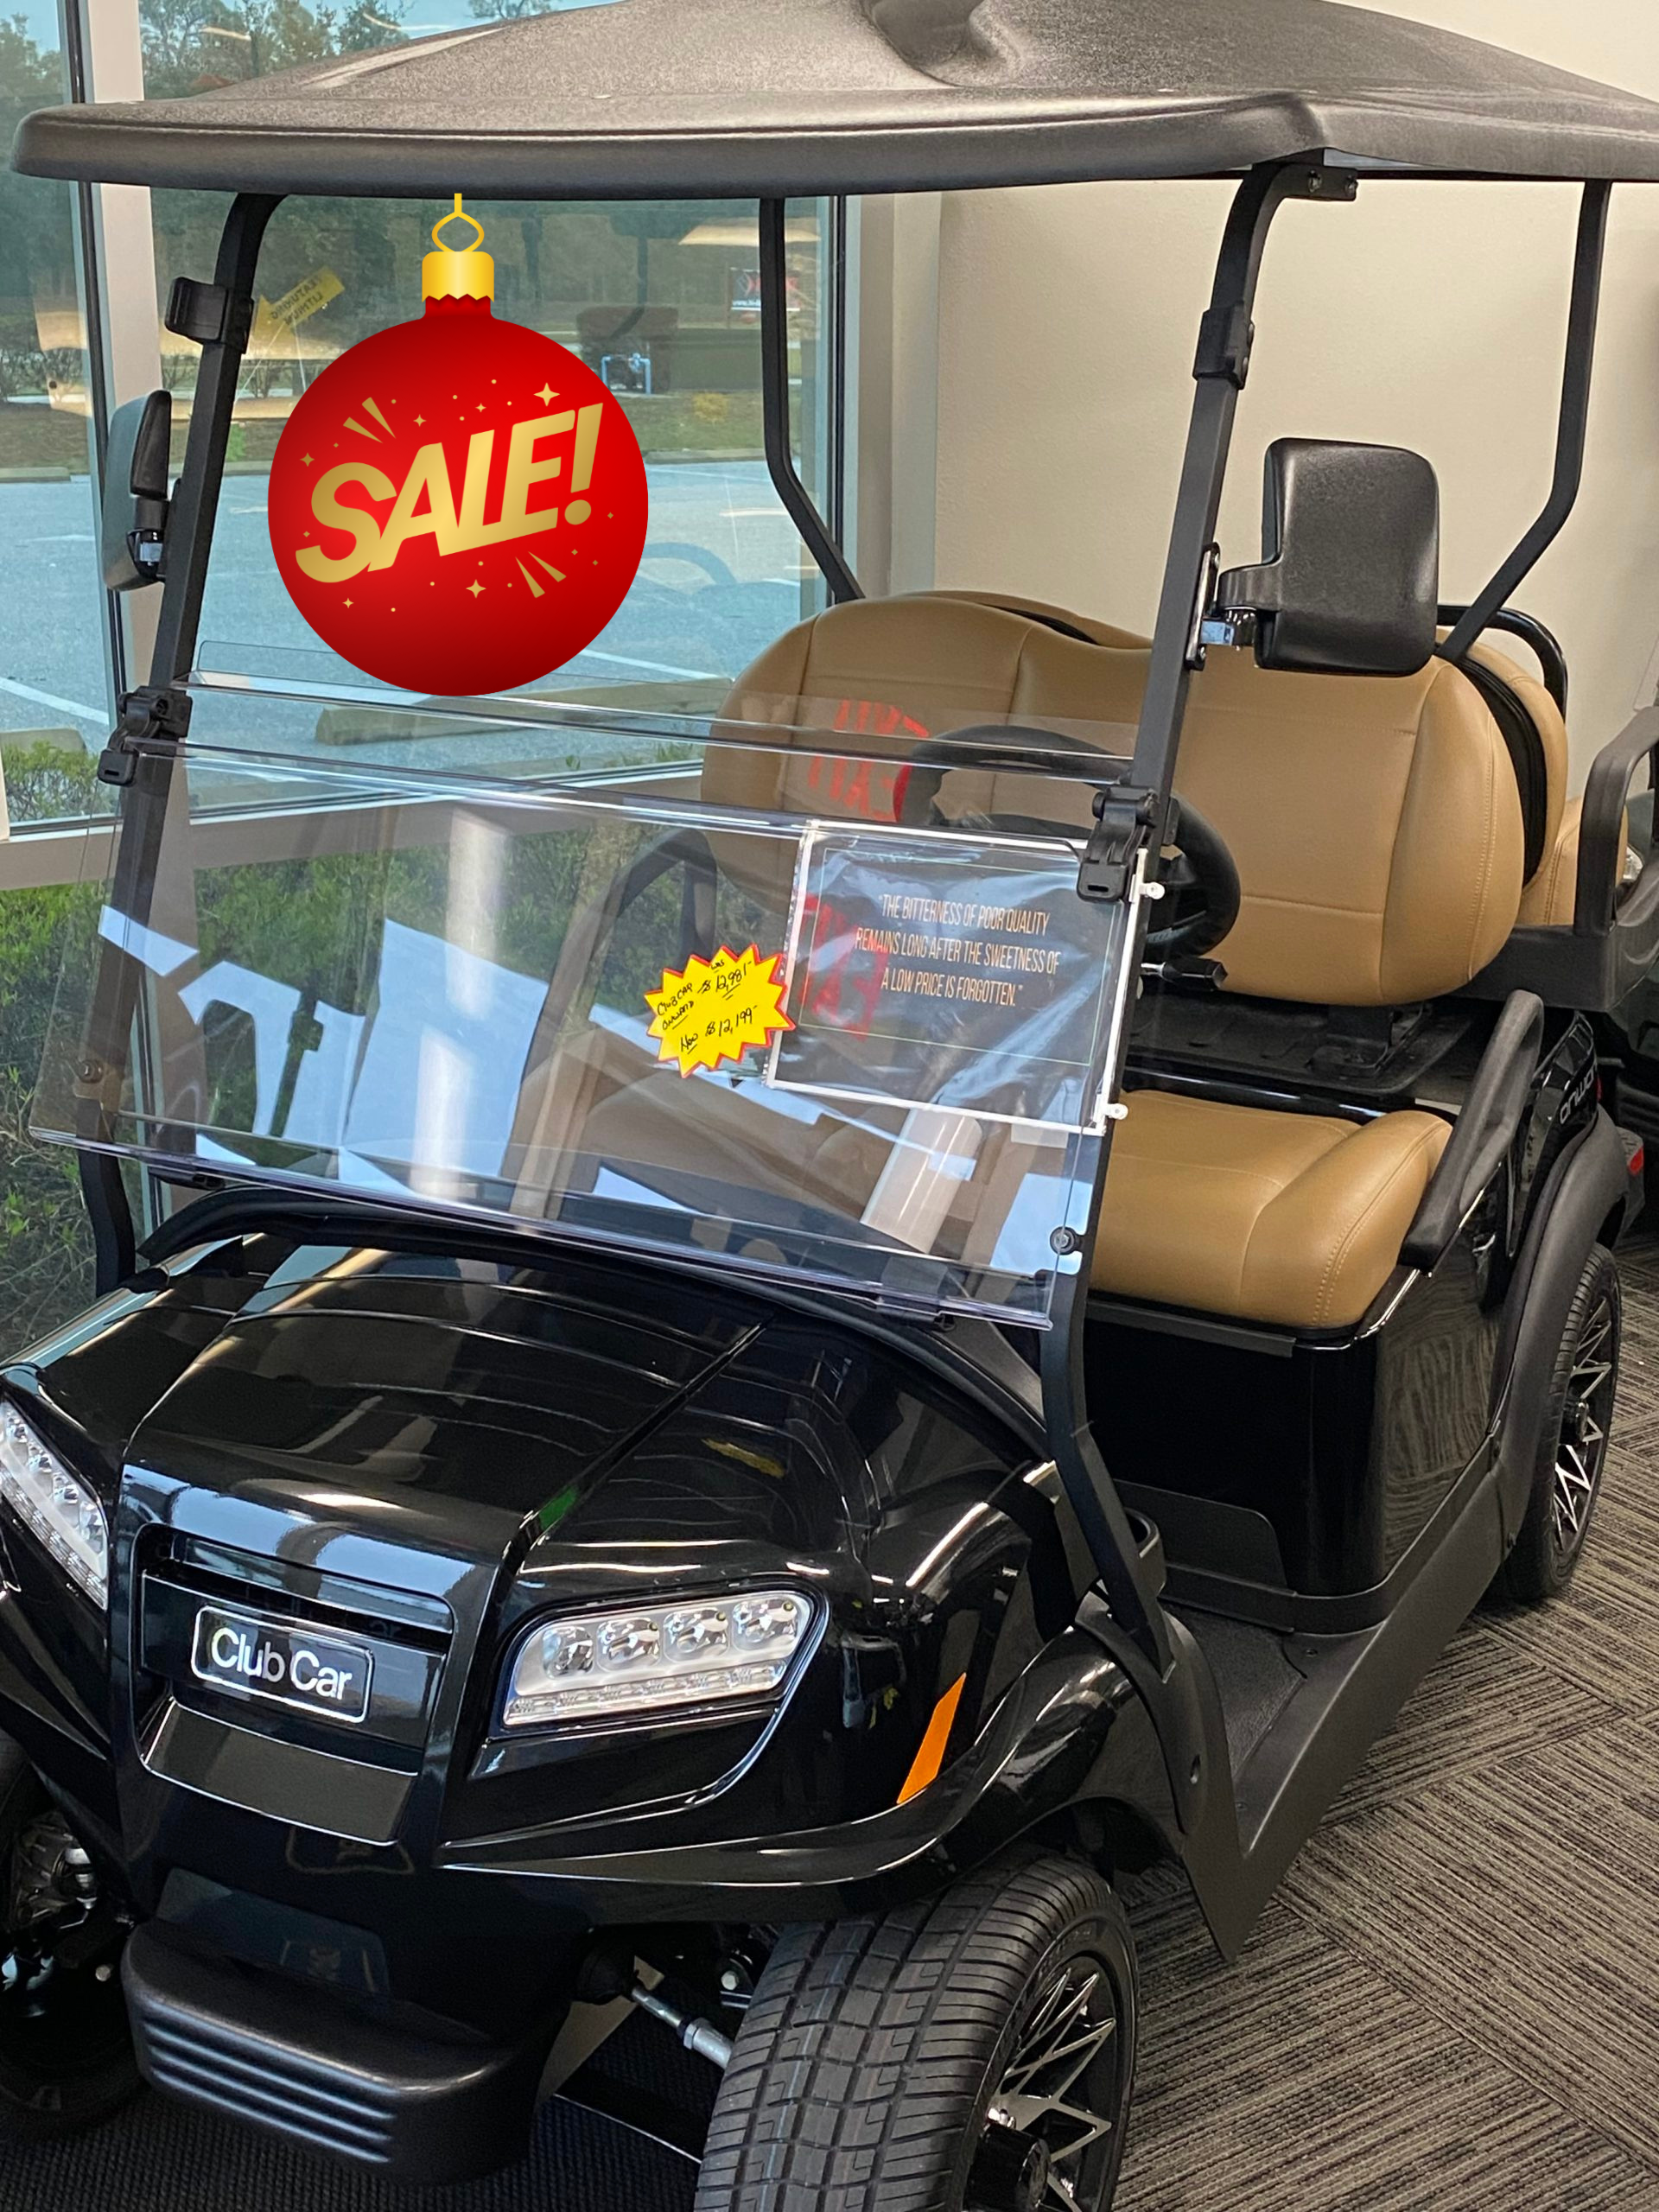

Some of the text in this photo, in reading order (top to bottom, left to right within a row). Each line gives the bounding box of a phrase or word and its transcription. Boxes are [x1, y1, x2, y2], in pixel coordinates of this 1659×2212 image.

[901, 896, 963, 925] BITTERNESS
[963, 904, 979, 927] OF
[976, 905, 1008, 931] POOR
[1005, 908, 1051, 937] QUALITY
[855, 926, 1062, 976] REMAINS LONG AFTER THE SWEETNESS OF
[880, 967, 890, 990] A
[890, 968, 916, 994] LOW
[914, 970, 945, 998] PRICE
[944, 975, 955, 999] IS
[211, 1627, 353, 1700] Club Car
